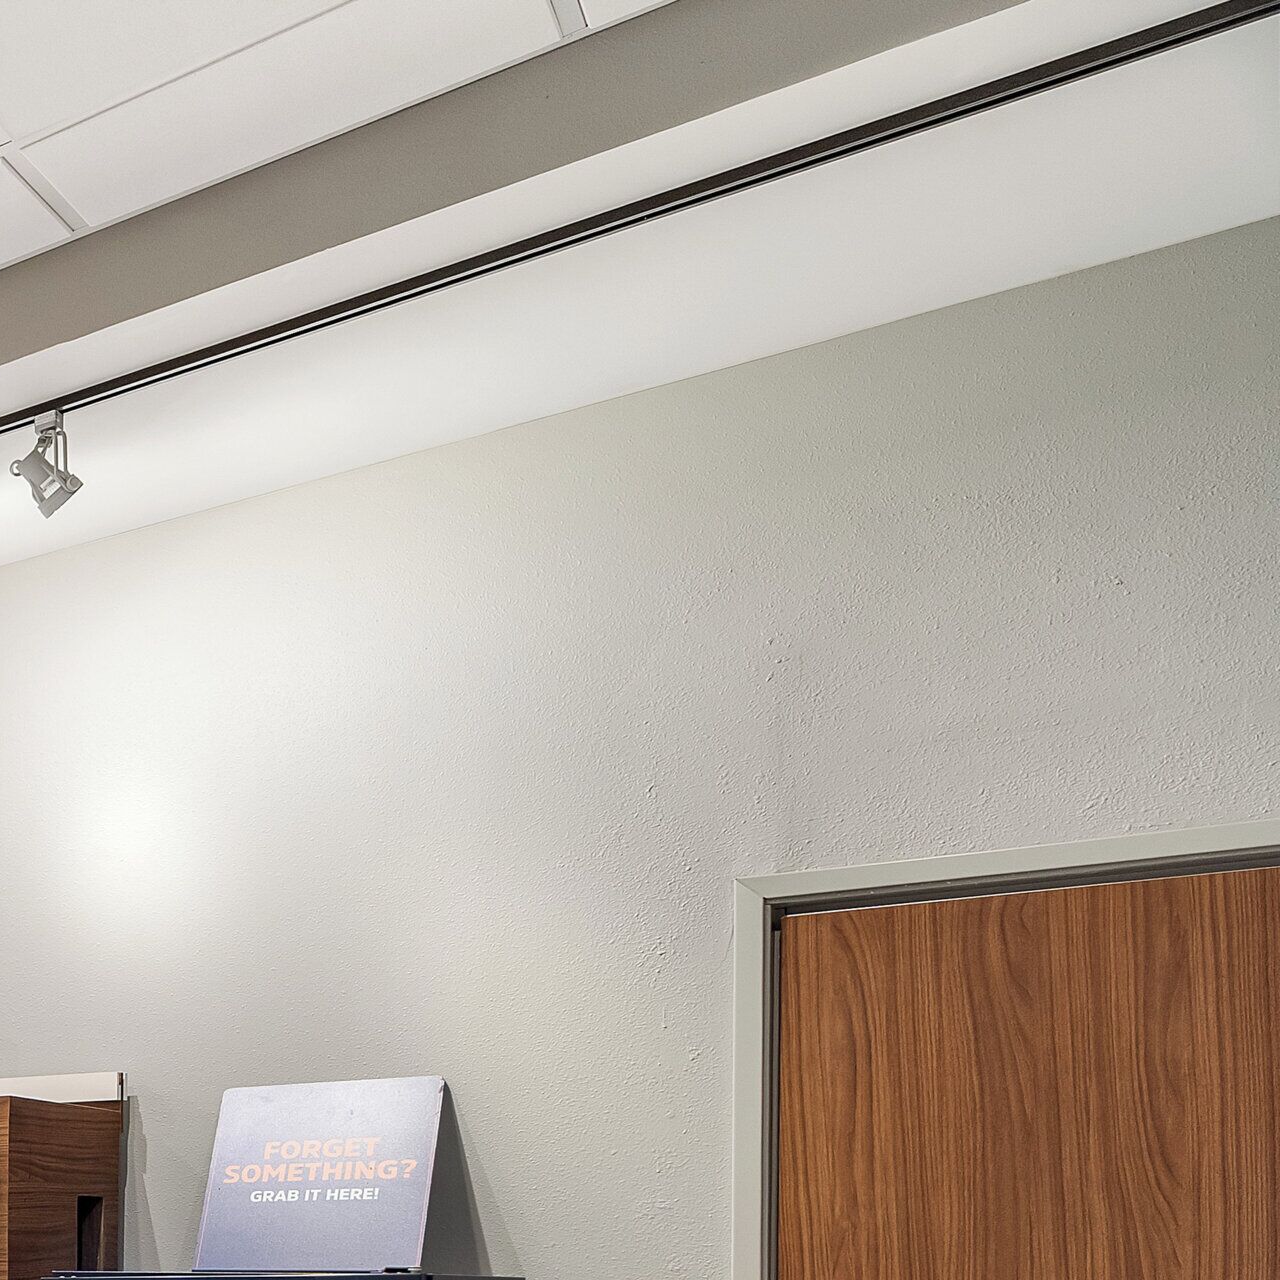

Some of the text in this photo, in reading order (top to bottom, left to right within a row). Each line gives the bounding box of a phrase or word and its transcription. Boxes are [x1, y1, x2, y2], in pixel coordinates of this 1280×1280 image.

[263, 1137, 382, 1160] FORGET
[223, 1159, 417, 1184] SOMETHING?
[250, 1187, 380, 1202] GRAB IT HERE!
